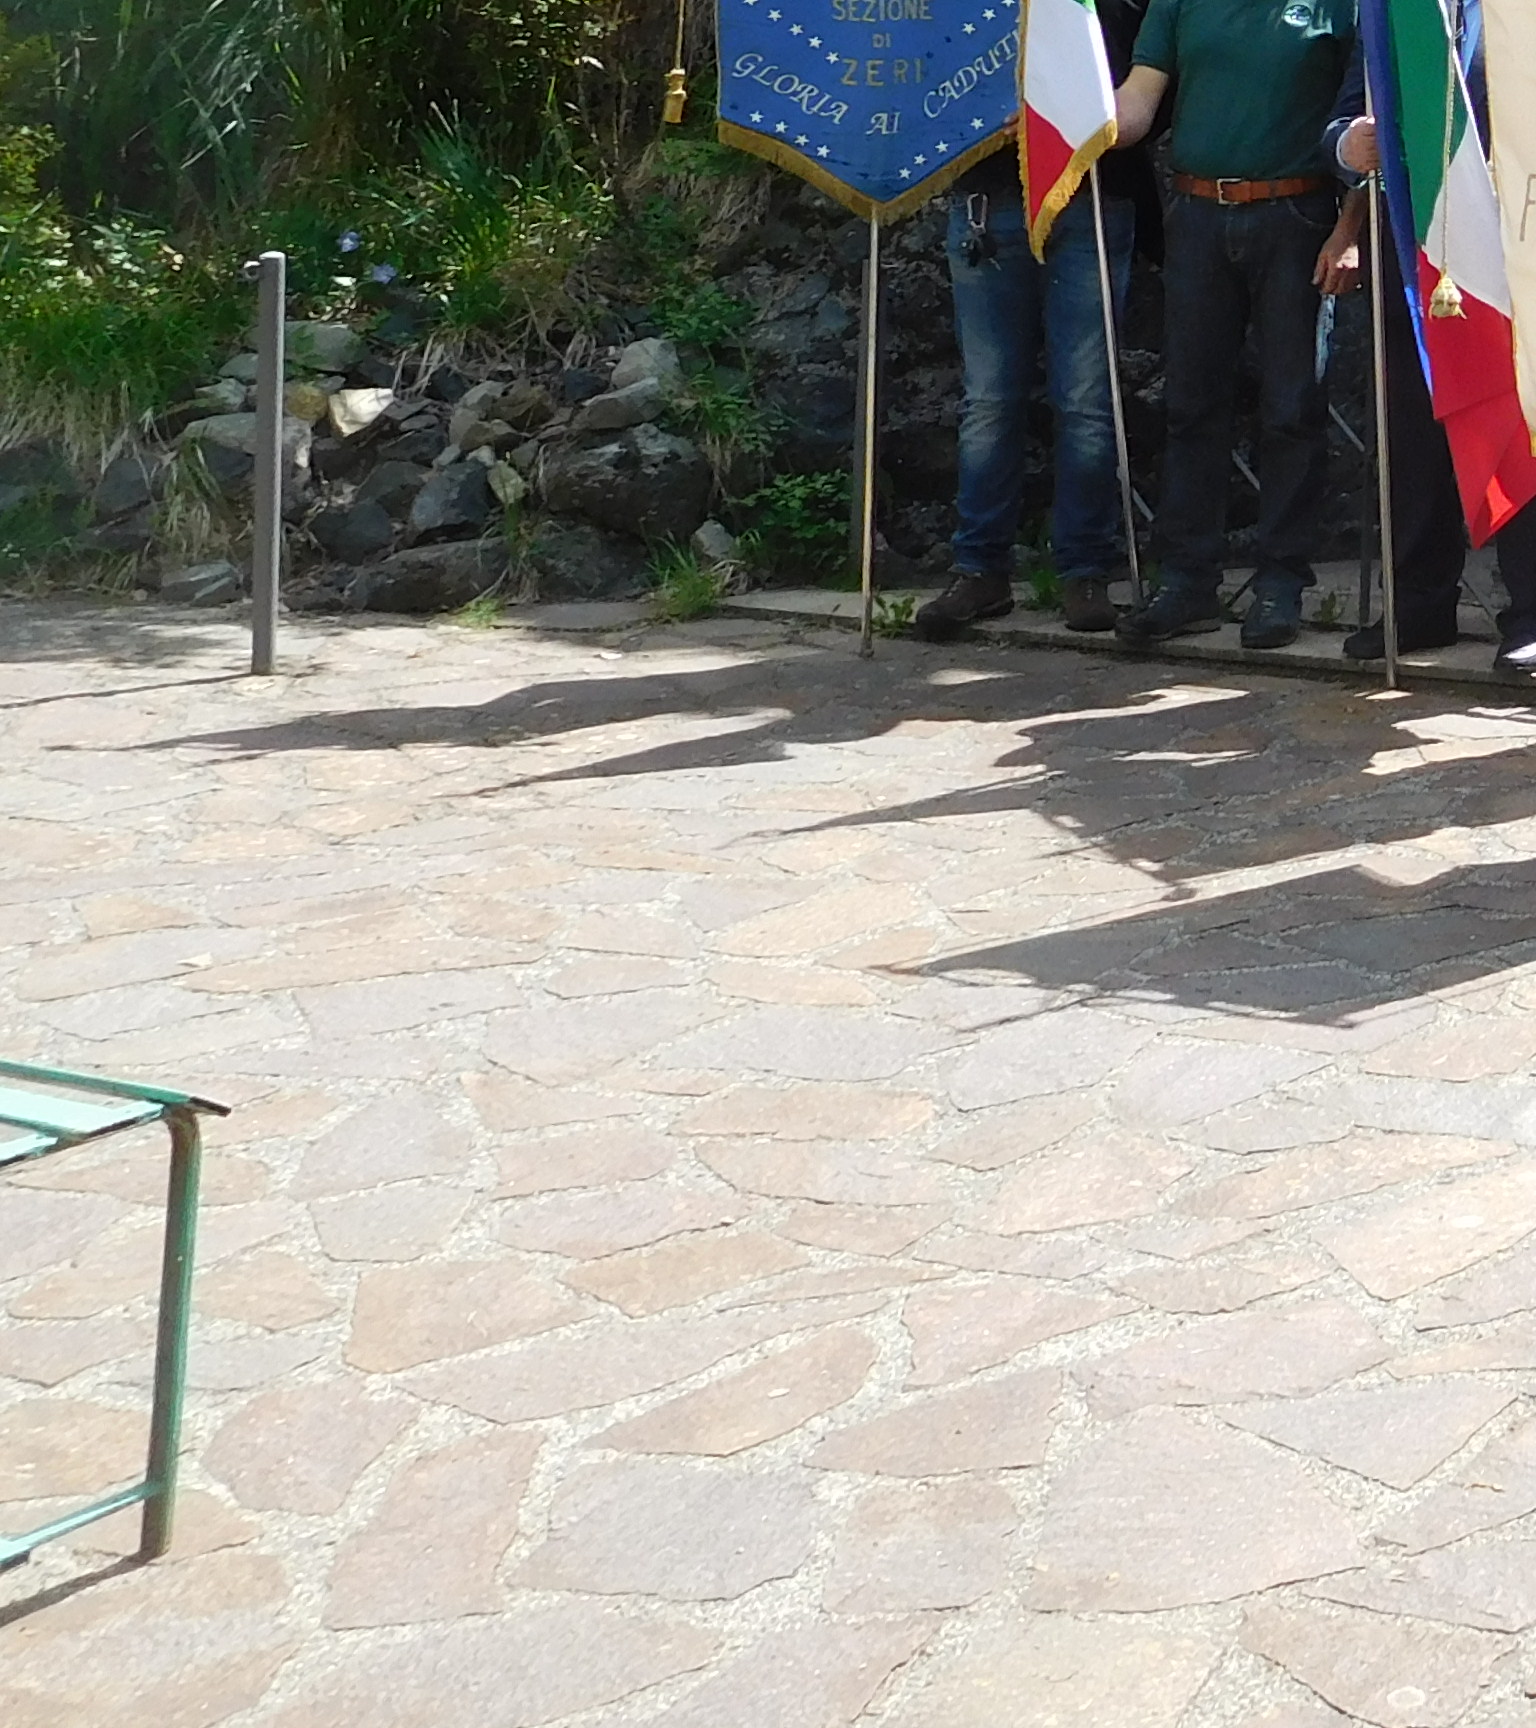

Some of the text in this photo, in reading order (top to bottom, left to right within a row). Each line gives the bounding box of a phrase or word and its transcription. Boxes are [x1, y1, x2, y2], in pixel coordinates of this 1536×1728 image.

[872, 34, 891, 48] DI
[841, 58, 925, 87] ZERI
[732, 52, 849, 125] GLORIA
[866, 112, 901, 134] AI
